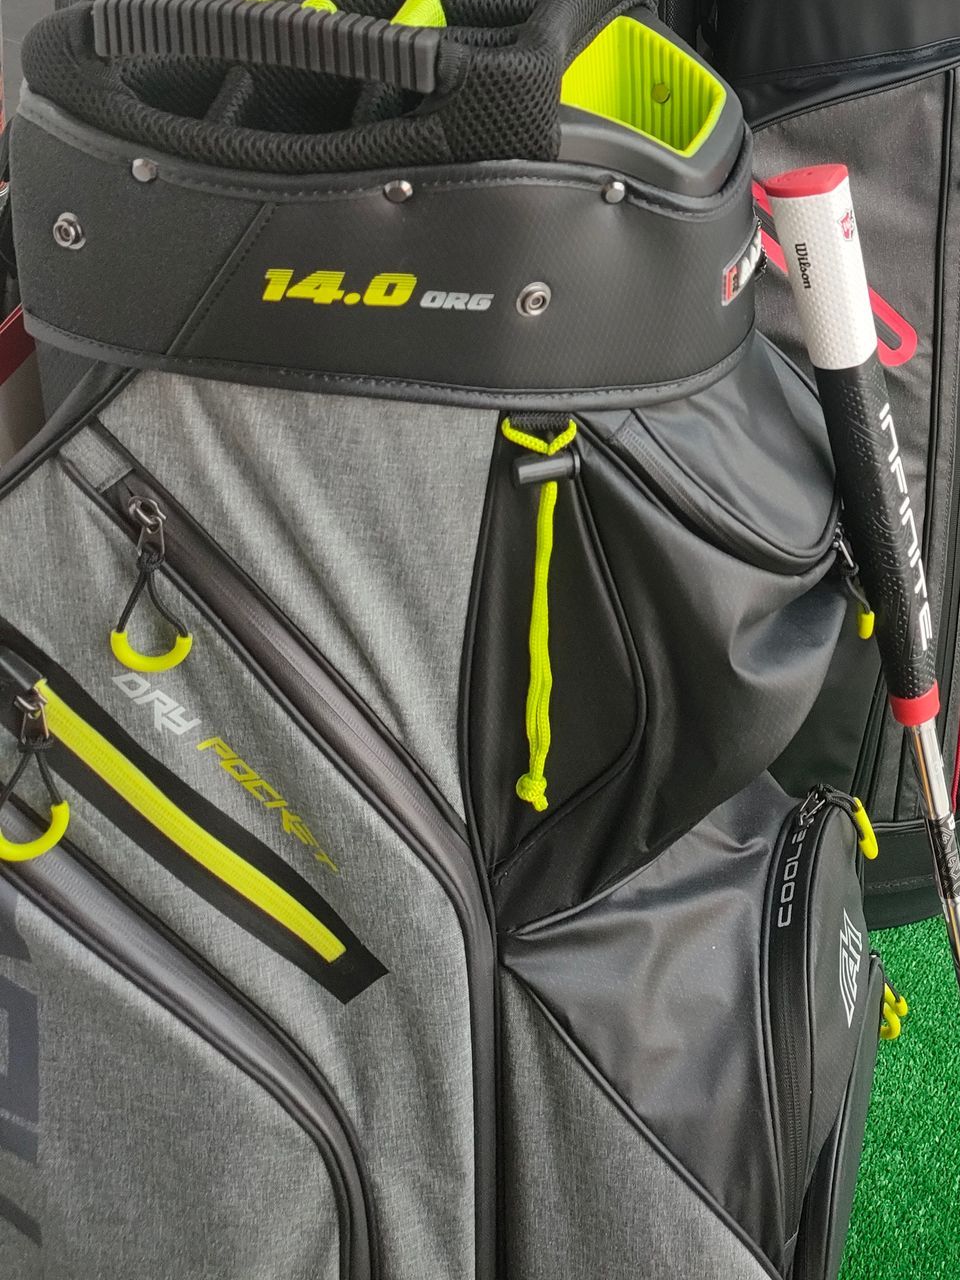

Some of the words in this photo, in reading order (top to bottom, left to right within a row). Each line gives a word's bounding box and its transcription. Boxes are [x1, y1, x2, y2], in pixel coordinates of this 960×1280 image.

[263, 268, 417, 306] 14.0
[419, 290, 495, 311] ORG
[795, 242, 812, 289] Wilson
[879, 402, 933, 652] INFINITE
[111, 672, 202, 735] DRY
[777, 818, 813, 928] COOLE
